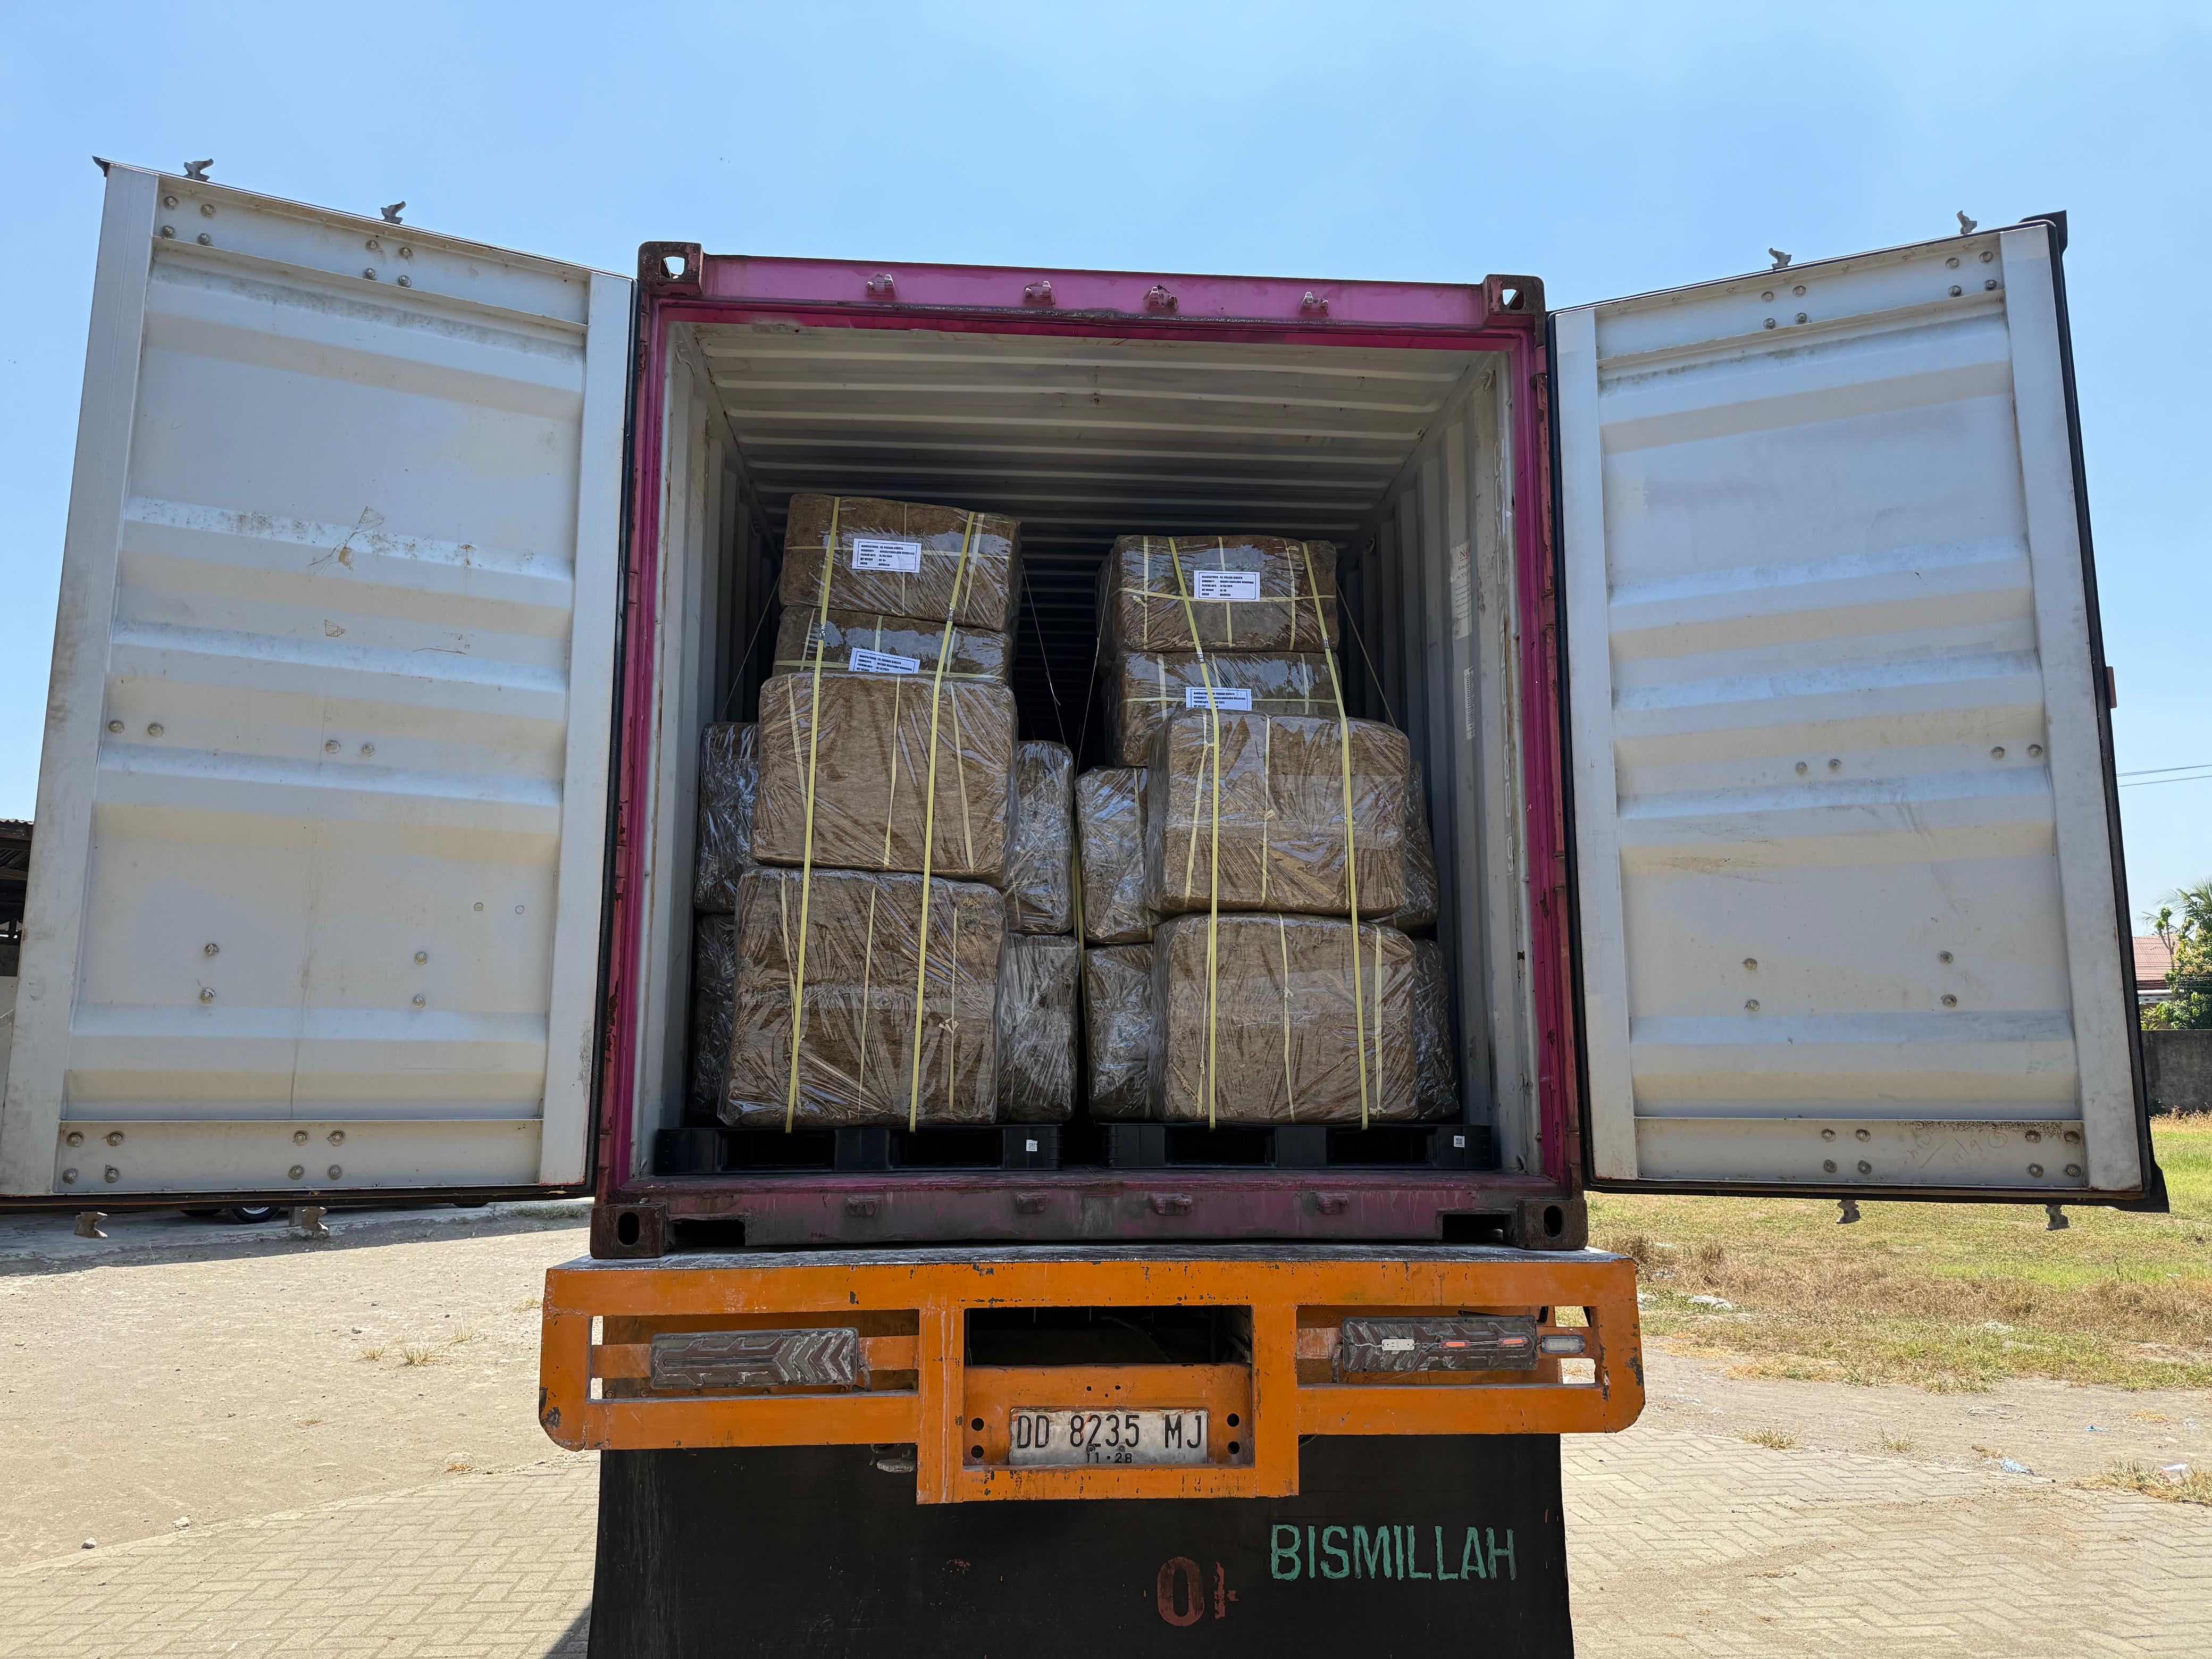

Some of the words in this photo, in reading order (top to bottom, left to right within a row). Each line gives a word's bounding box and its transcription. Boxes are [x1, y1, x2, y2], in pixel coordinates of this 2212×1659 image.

[1017, 1415, 1050, 1448] DD
[1070, 1414, 1140, 1447] 8235
[1164, 1414, 1202, 1448] MJ
[1270, 1524, 1516, 1581] BISMILLAH
